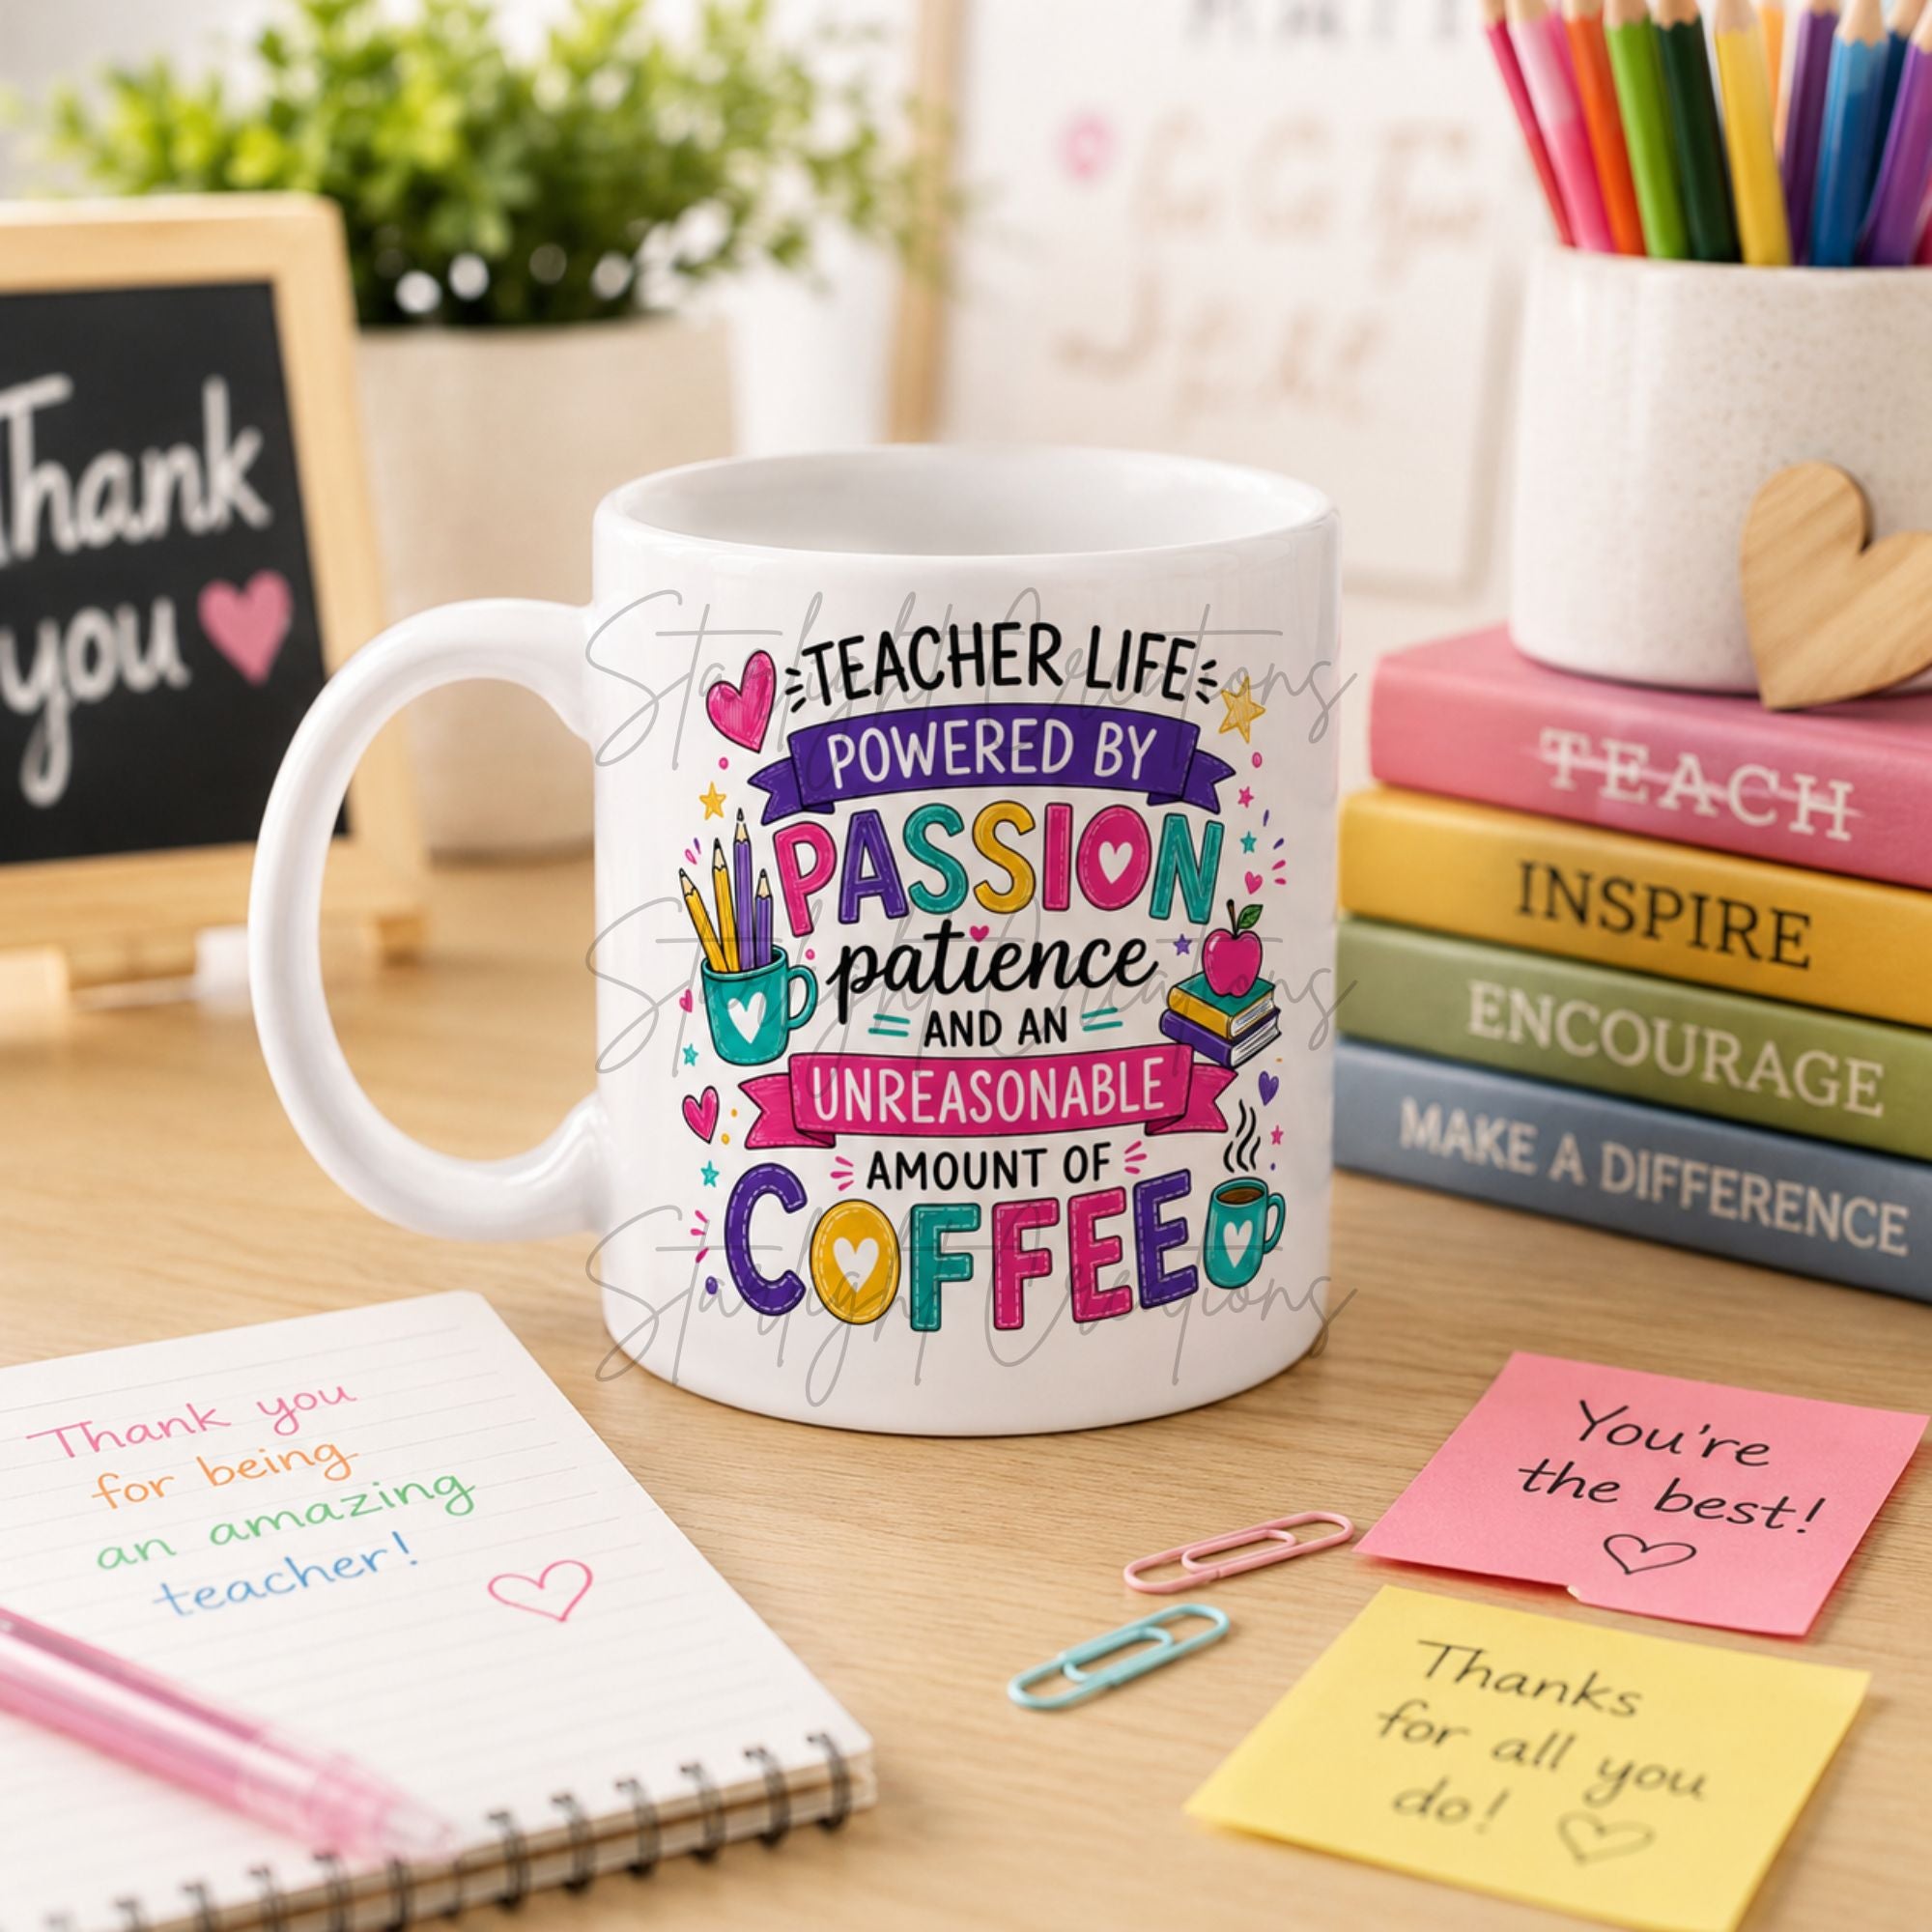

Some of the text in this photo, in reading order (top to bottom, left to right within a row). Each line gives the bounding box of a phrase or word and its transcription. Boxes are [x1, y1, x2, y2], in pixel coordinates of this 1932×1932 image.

[802, 622, 1197, 707] TEACHER LIFE
[827, 717, 1158, 789] POWERED BY
[1538, 727, 1854, 841] TEACH
[773, 800, 1224, 937] PASSION
[1518, 861, 1812, 971] INSPIRE
[825, 918, 1159, 1025] patience
[923, 1006, 1068, 1048] AND AN
[1466, 979, 1885, 1118] ENCOURAGE
[811, 1057, 1165, 1124] UNREASONABLE
[866, 1142, 1112, 1191] AMOUNT OF
[1399, 1097, 1910, 1257] MAKE A DIFFERENCE
[724, 1162, 1200, 1333] COFFEE
[25, 1381, 357, 1459] Thank you
[1578, 1399, 1772, 1467] You're
[91, 1441, 360, 1510] for being
[1519, 1459, 1827, 1534] the best!
[97, 1474, 476, 1571] an amazing
[152, 1530, 419, 1617] teacher!
[1417, 1639, 1643, 1719] Thanks
[1376, 1699, 1710, 1808] for all you
[1391, 1778, 1513, 1833] do!
